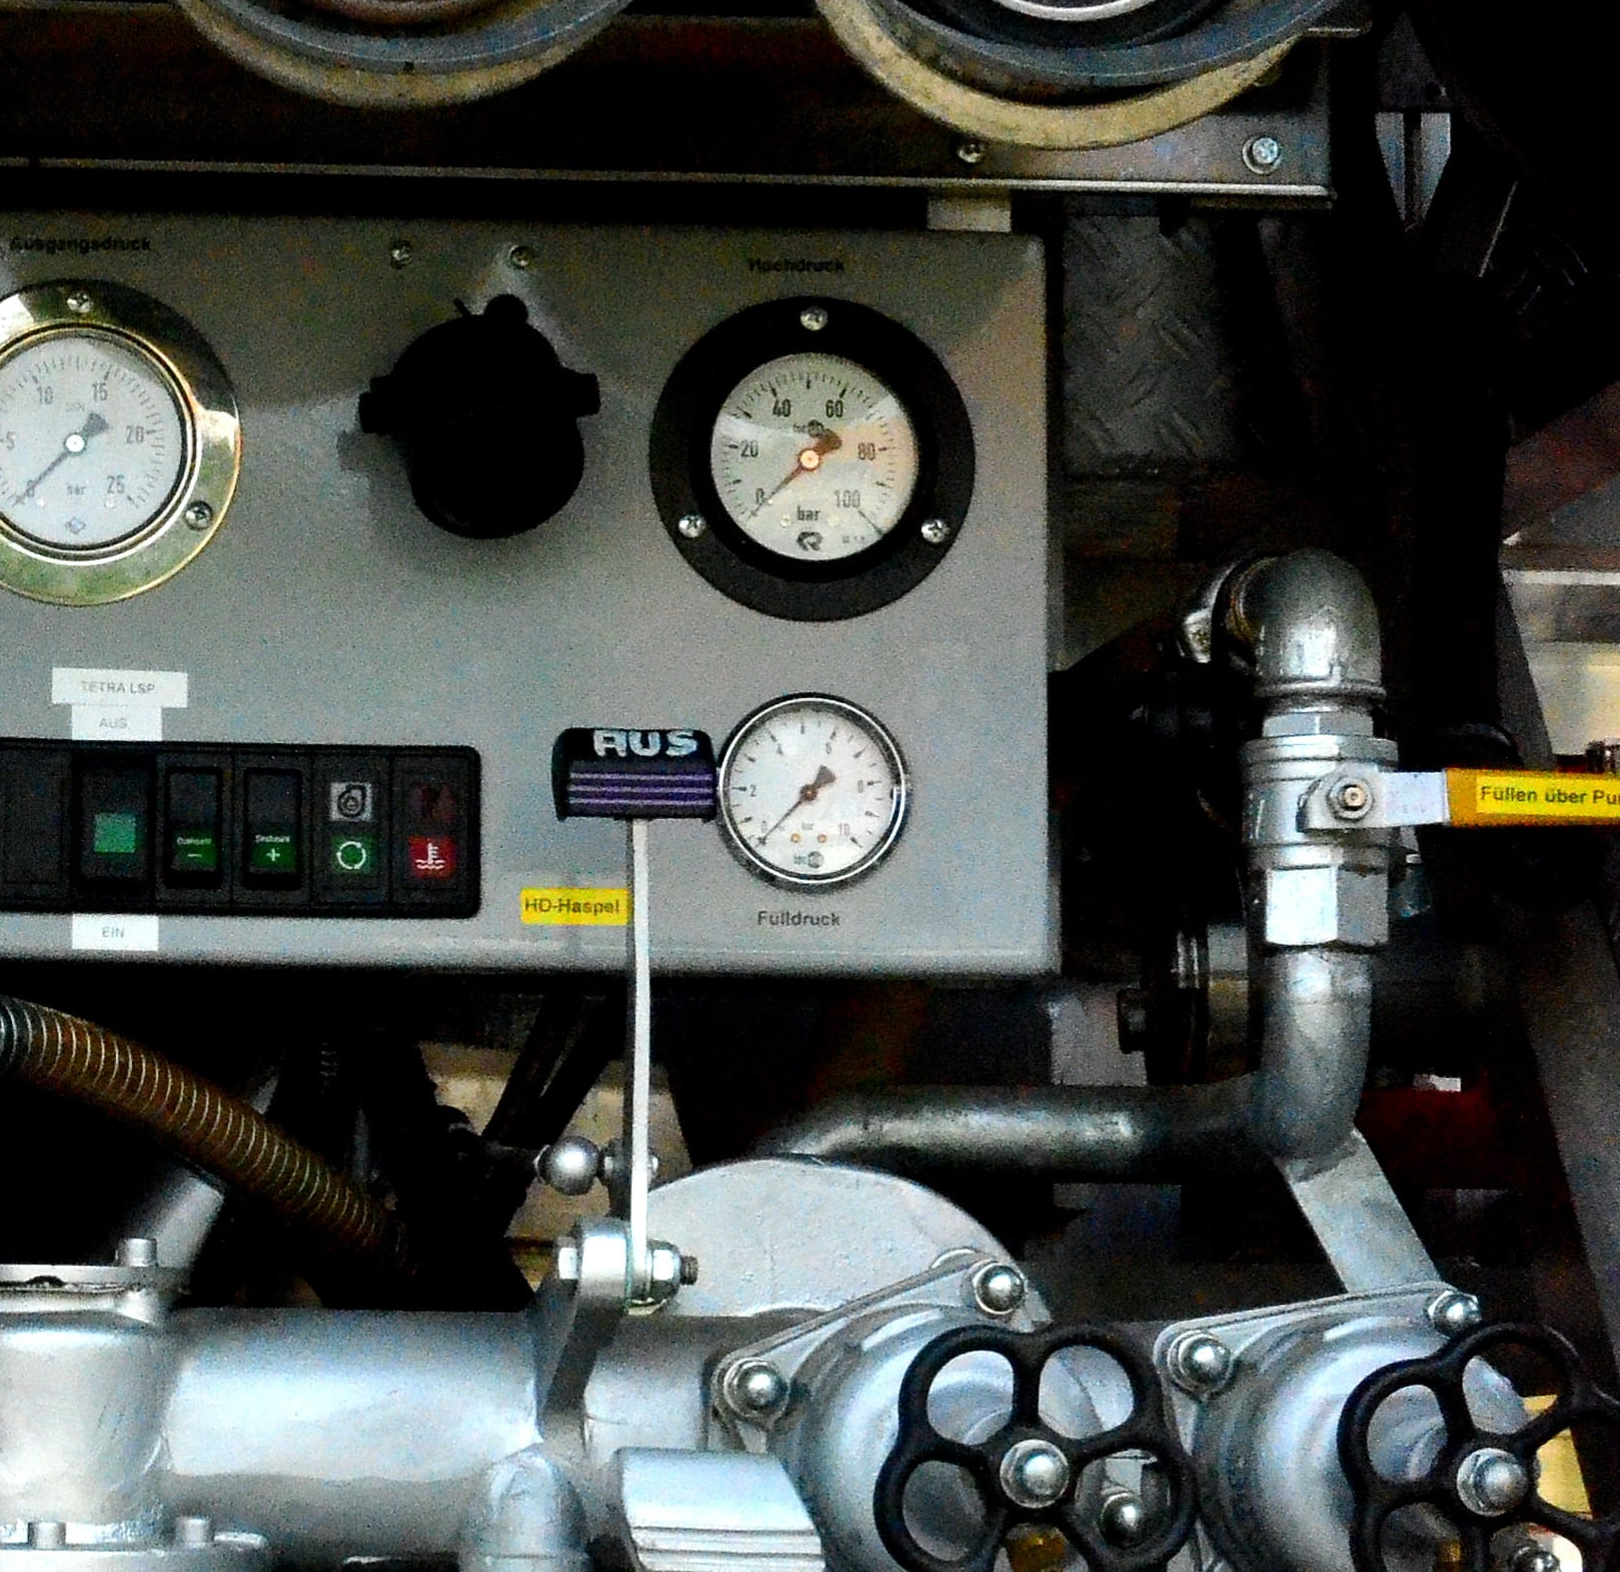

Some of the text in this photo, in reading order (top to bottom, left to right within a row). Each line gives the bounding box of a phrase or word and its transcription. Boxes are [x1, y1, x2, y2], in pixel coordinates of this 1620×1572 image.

[10, 235, 150, 255] Ausgangsdruck
[36, 385, 54, 405] 10
[91, 382, 109, 401] 15
[772, 398, 792, 418] 40
[826, 399, 845, 418] 60
[5, 431, 16, 451] 5
[125, 426, 145, 445] 20
[740, 440, 759, 458] 20
[857, 442, 876, 461] 80
[107, 475, 125, 494] 25
[833, 489, 861, 509] 100
[796, 506, 821, 521] bar
[80, 680, 156, 694] TETRA LSP
[99, 717, 128, 729] AUS
[593, 729, 698, 758] AUS
[749, 784, 757, 798] 2
[1592, 789, 1620, 805] Pu
[524, 897, 621, 916] HD-Haspel
[101, 926, 126, 939] EIN
